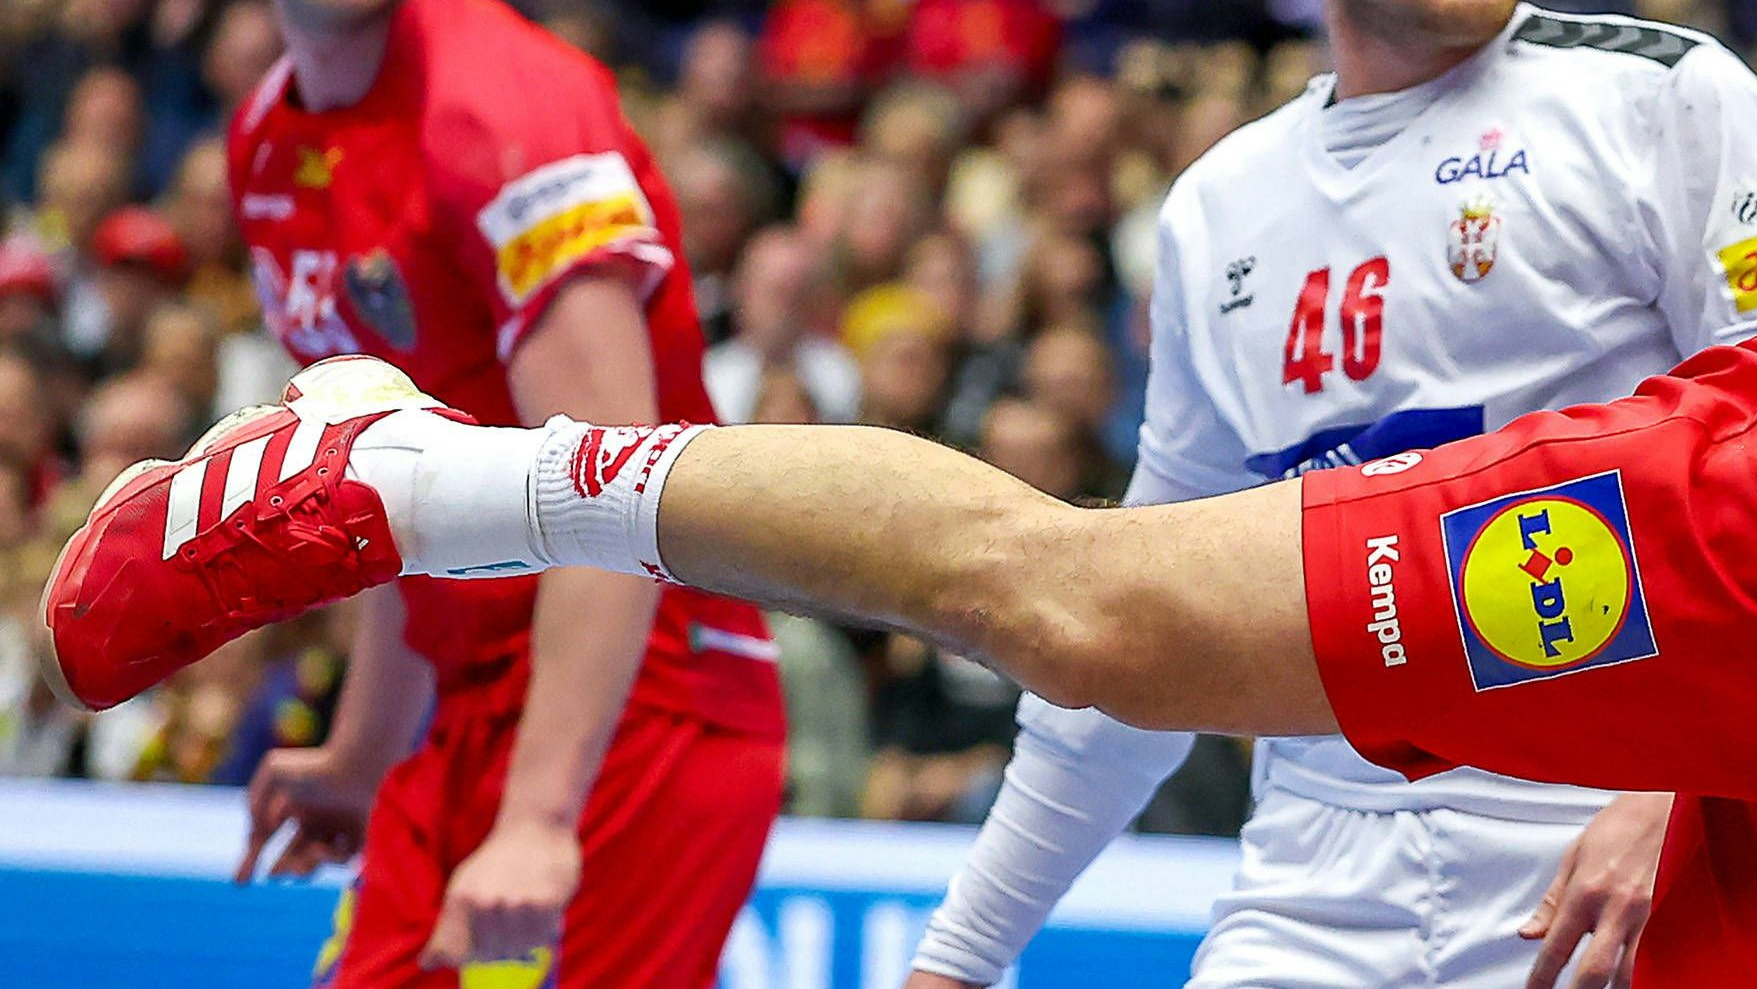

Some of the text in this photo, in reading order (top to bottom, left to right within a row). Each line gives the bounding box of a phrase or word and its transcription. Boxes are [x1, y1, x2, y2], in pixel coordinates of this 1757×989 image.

[1435, 150, 1529, 184] GALA
[1281, 255, 1390, 395] 46
[1366, 536, 1407, 668] Kempa
